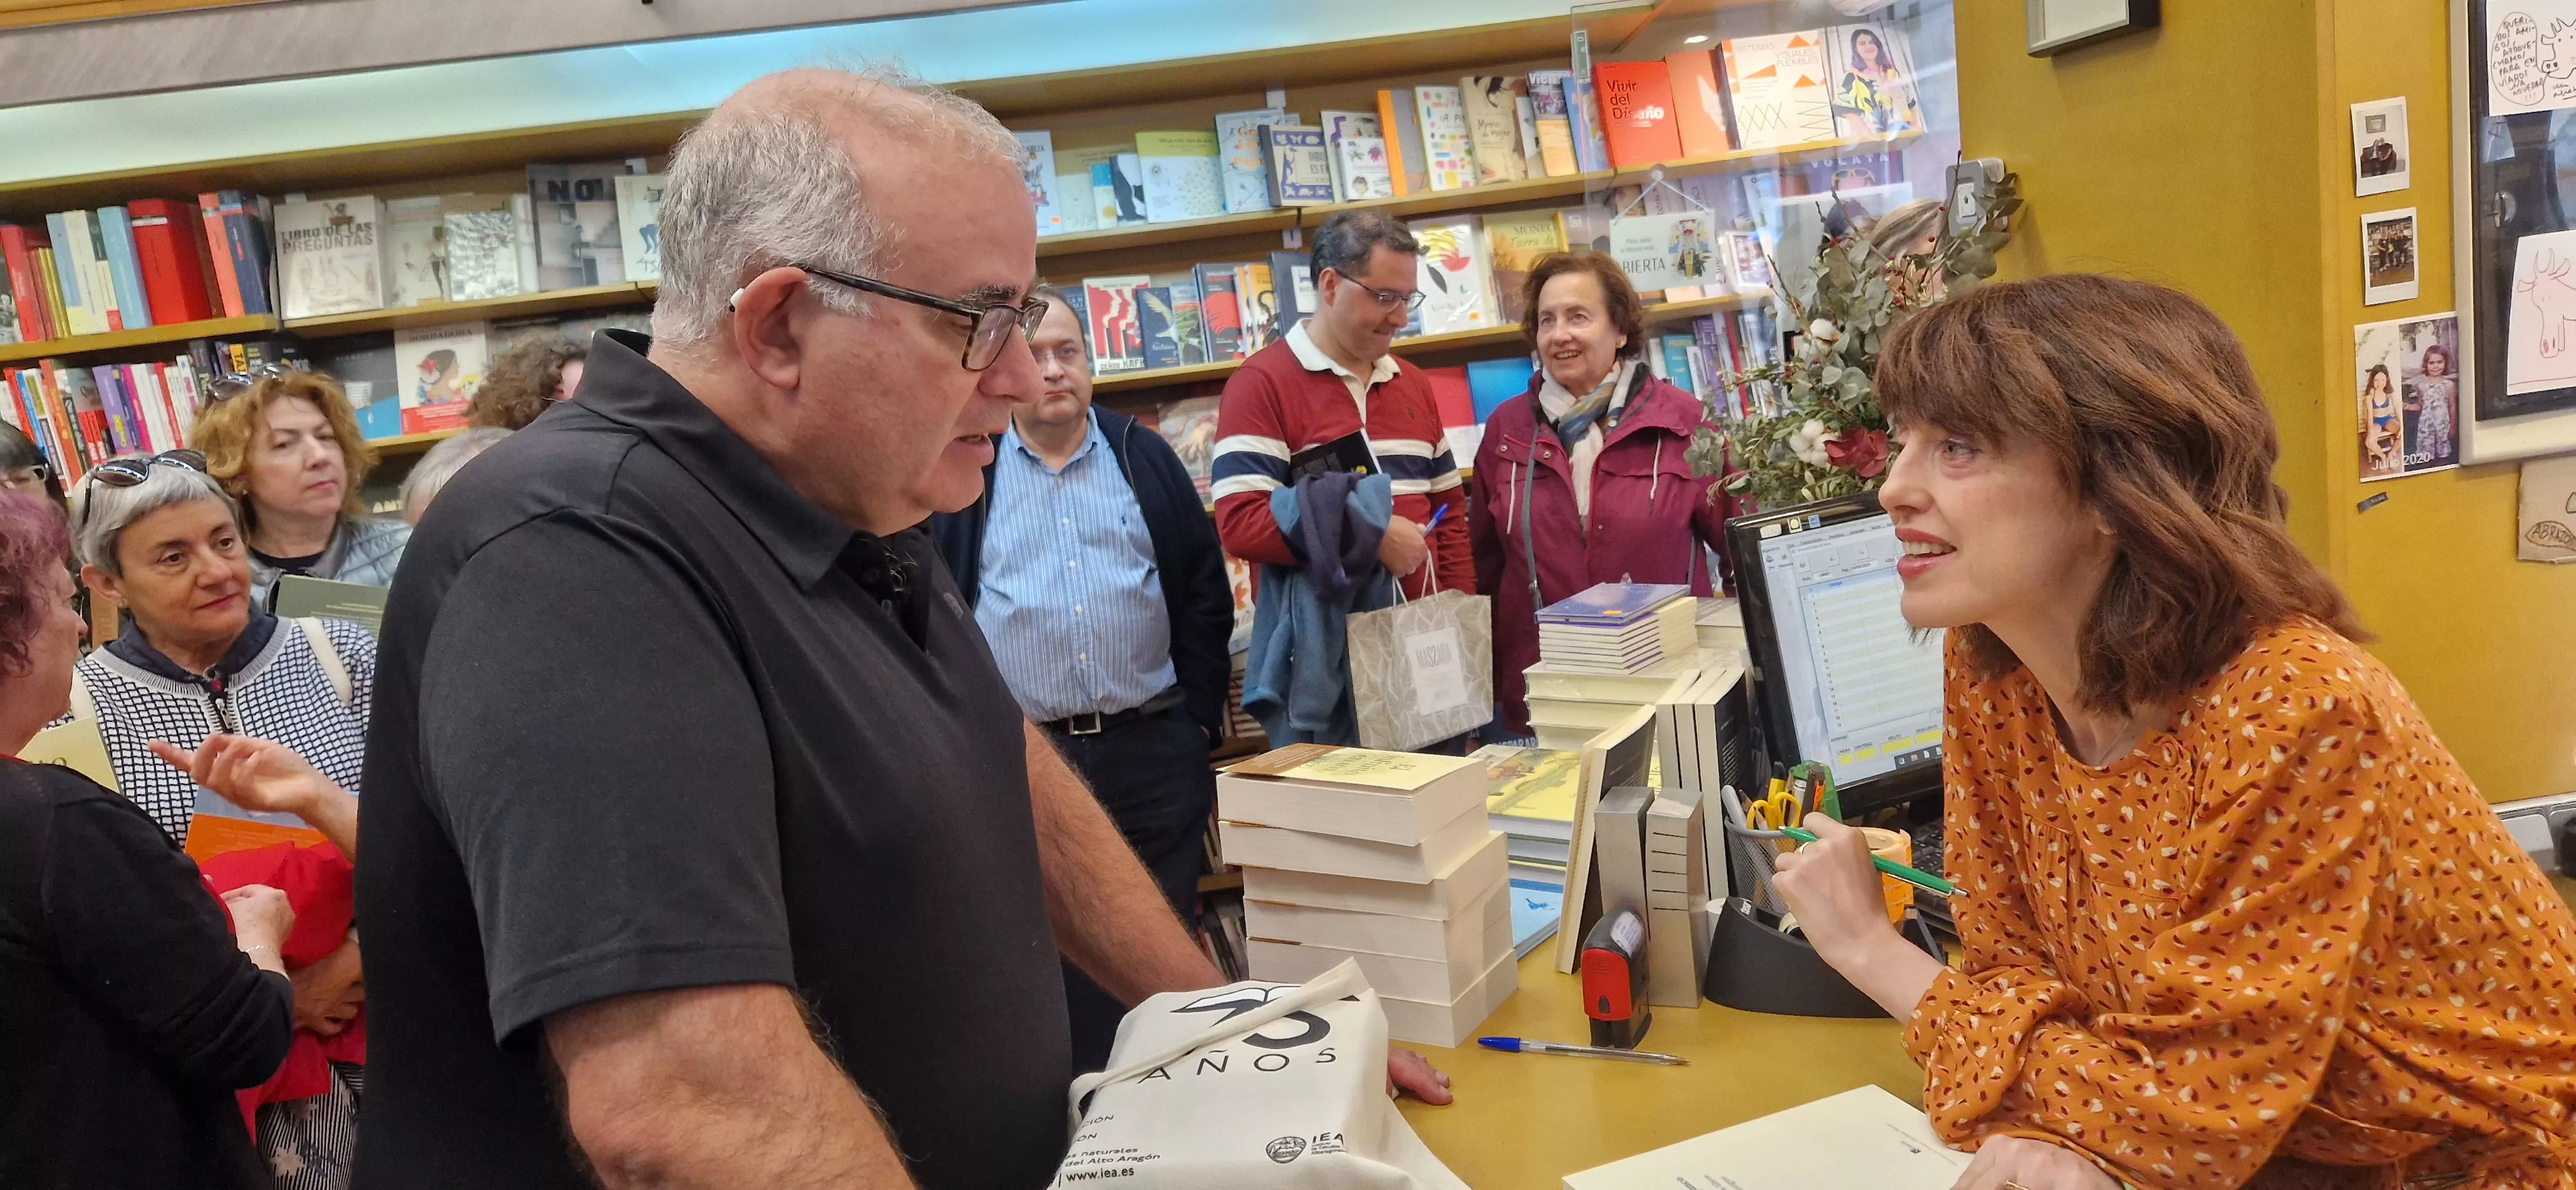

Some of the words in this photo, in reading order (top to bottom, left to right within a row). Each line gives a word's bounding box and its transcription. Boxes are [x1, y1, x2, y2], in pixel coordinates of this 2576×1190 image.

[1736, 42, 1776, 53] SISTEMAS
[1774, 49, 1815, 59] VISUALES
[1776, 56, 1821, 67] FLEXIBLES
[1606, 79, 1637, 92] Vivir
[1610, 93, 1631, 106] del
[281, 233, 374, 255] PREGUNTAS
[1622, 257, 1665, 276] BIERTA
[1122, 357, 1146, 369] KAFK
[2403, 451, 2432, 466] 2020
[1137, 1047, 1336, 1084] AÑOS
[1312, 1131, 1344, 1146] IEA
[1081, 1148, 1139, 1157] naturales
[1117, 1153, 1160, 1163] Aragón
[1066, 1167, 1135, 1183] www.iea.es
